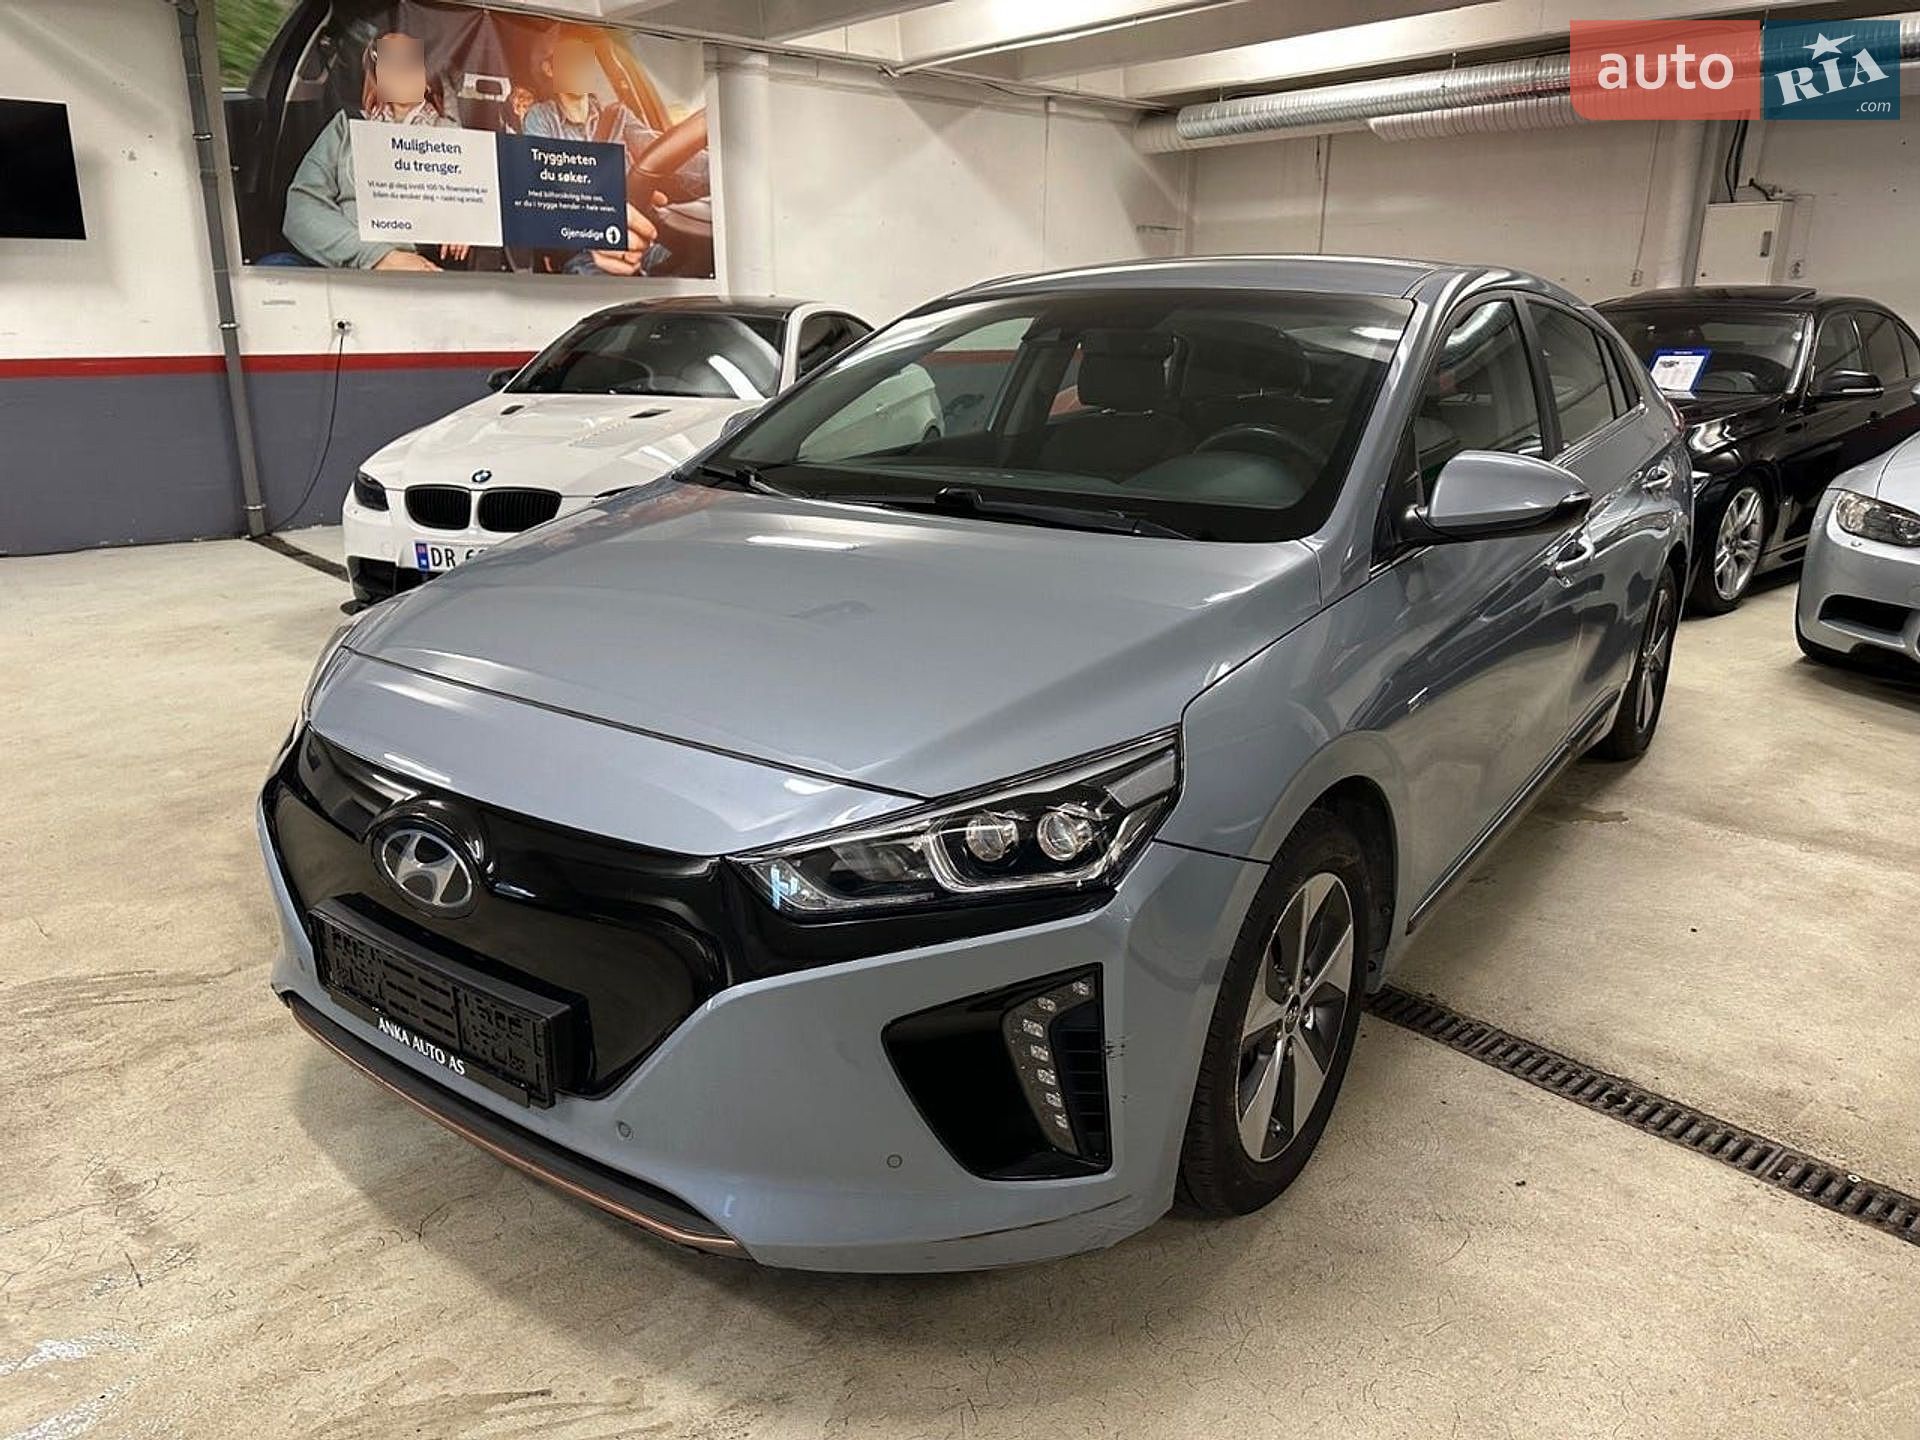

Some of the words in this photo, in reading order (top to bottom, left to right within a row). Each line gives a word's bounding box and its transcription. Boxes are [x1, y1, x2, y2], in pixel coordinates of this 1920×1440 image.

[391, 137, 462, 154] Muligheten
[531, 148, 597, 166] Tryggheten
[394, 158, 411, 171] du
[414, 161, 462, 175] trenger.
[540, 168, 555, 181] du
[558, 170, 591, 184] søker.
[371, 219, 412, 230] Nordea
[560, 227, 604, 241] Gjensidige
[430, 547, 456, 567] DR
[378, 1017, 410, 1046] ANKA
[413, 1035, 446, 1064] AUTO
[449, 1055, 465, 1075] AS
